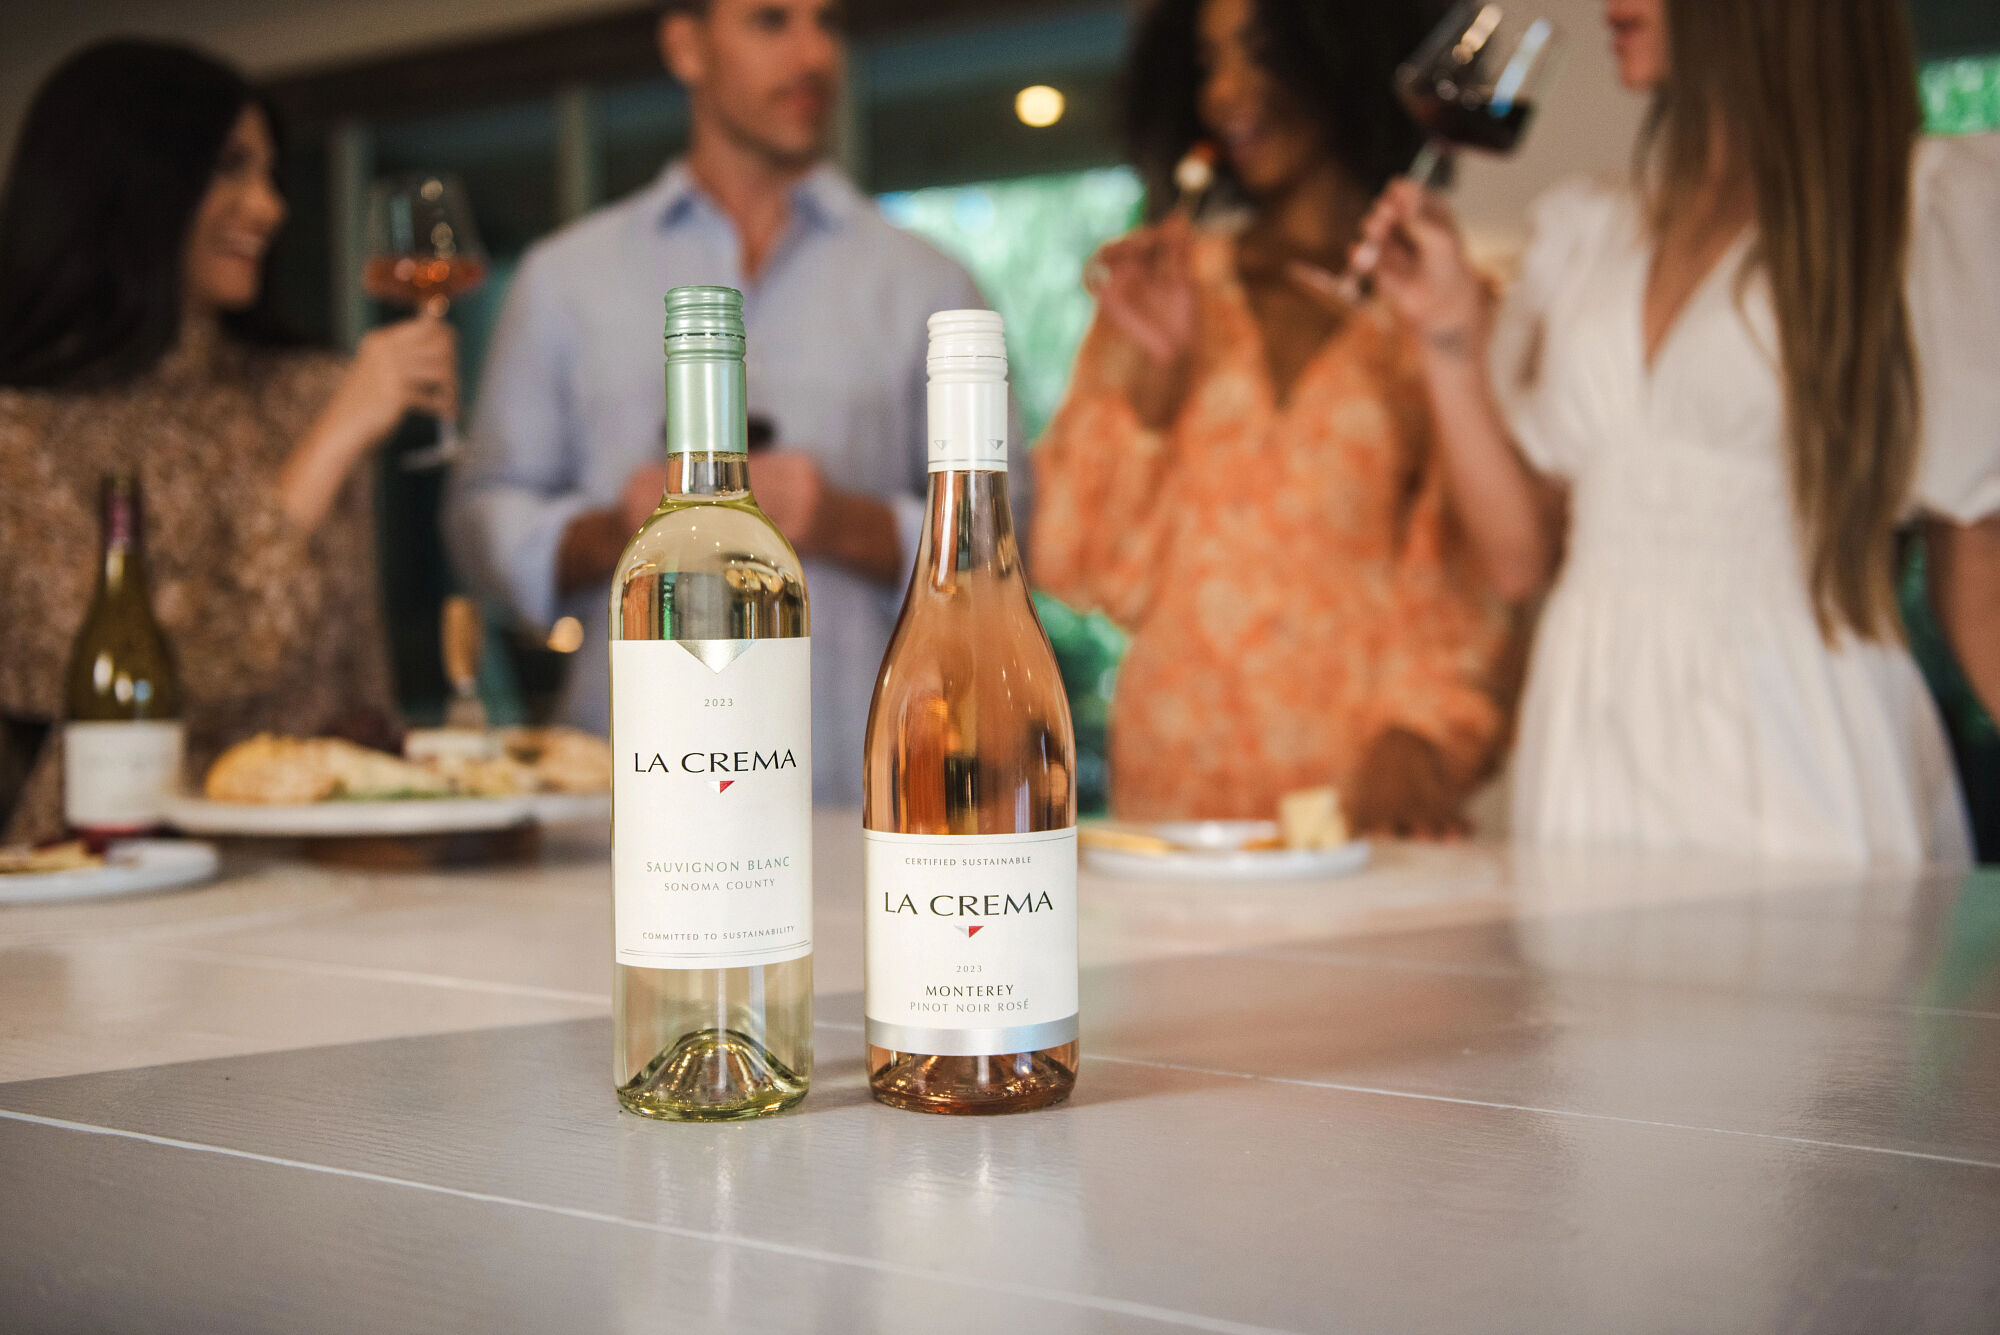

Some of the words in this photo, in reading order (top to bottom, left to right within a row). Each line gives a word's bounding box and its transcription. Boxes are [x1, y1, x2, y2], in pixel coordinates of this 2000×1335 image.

[704, 698, 734, 707] 2023
[634, 752, 669, 773] LA
[681, 749, 797, 773] CREMA
[646, 861, 740, 873] SAUVIGNON
[747, 856, 791, 871] BLANC
[905, 857, 957, 866] CERTIFIED
[962, 856, 1032, 866] SUSTAINABLE
[664, 881, 720, 892] SONOMA
[726, 878, 776, 890] COUNTY
[884, 891, 918, 915] LA
[929, 890, 1054, 917] CREMA
[642, 932, 699, 941] COMMITTED
[723, 926, 795, 939] SUSTAINABILITY
[956, 965, 983, 973] 2023
[925, 984, 1014, 997] MONTEREY
[910, 1001, 949, 1013] PINOT
[956, 1003, 990, 1013] NOIR
[997, 998, 1029, 1012] ROSÉ
